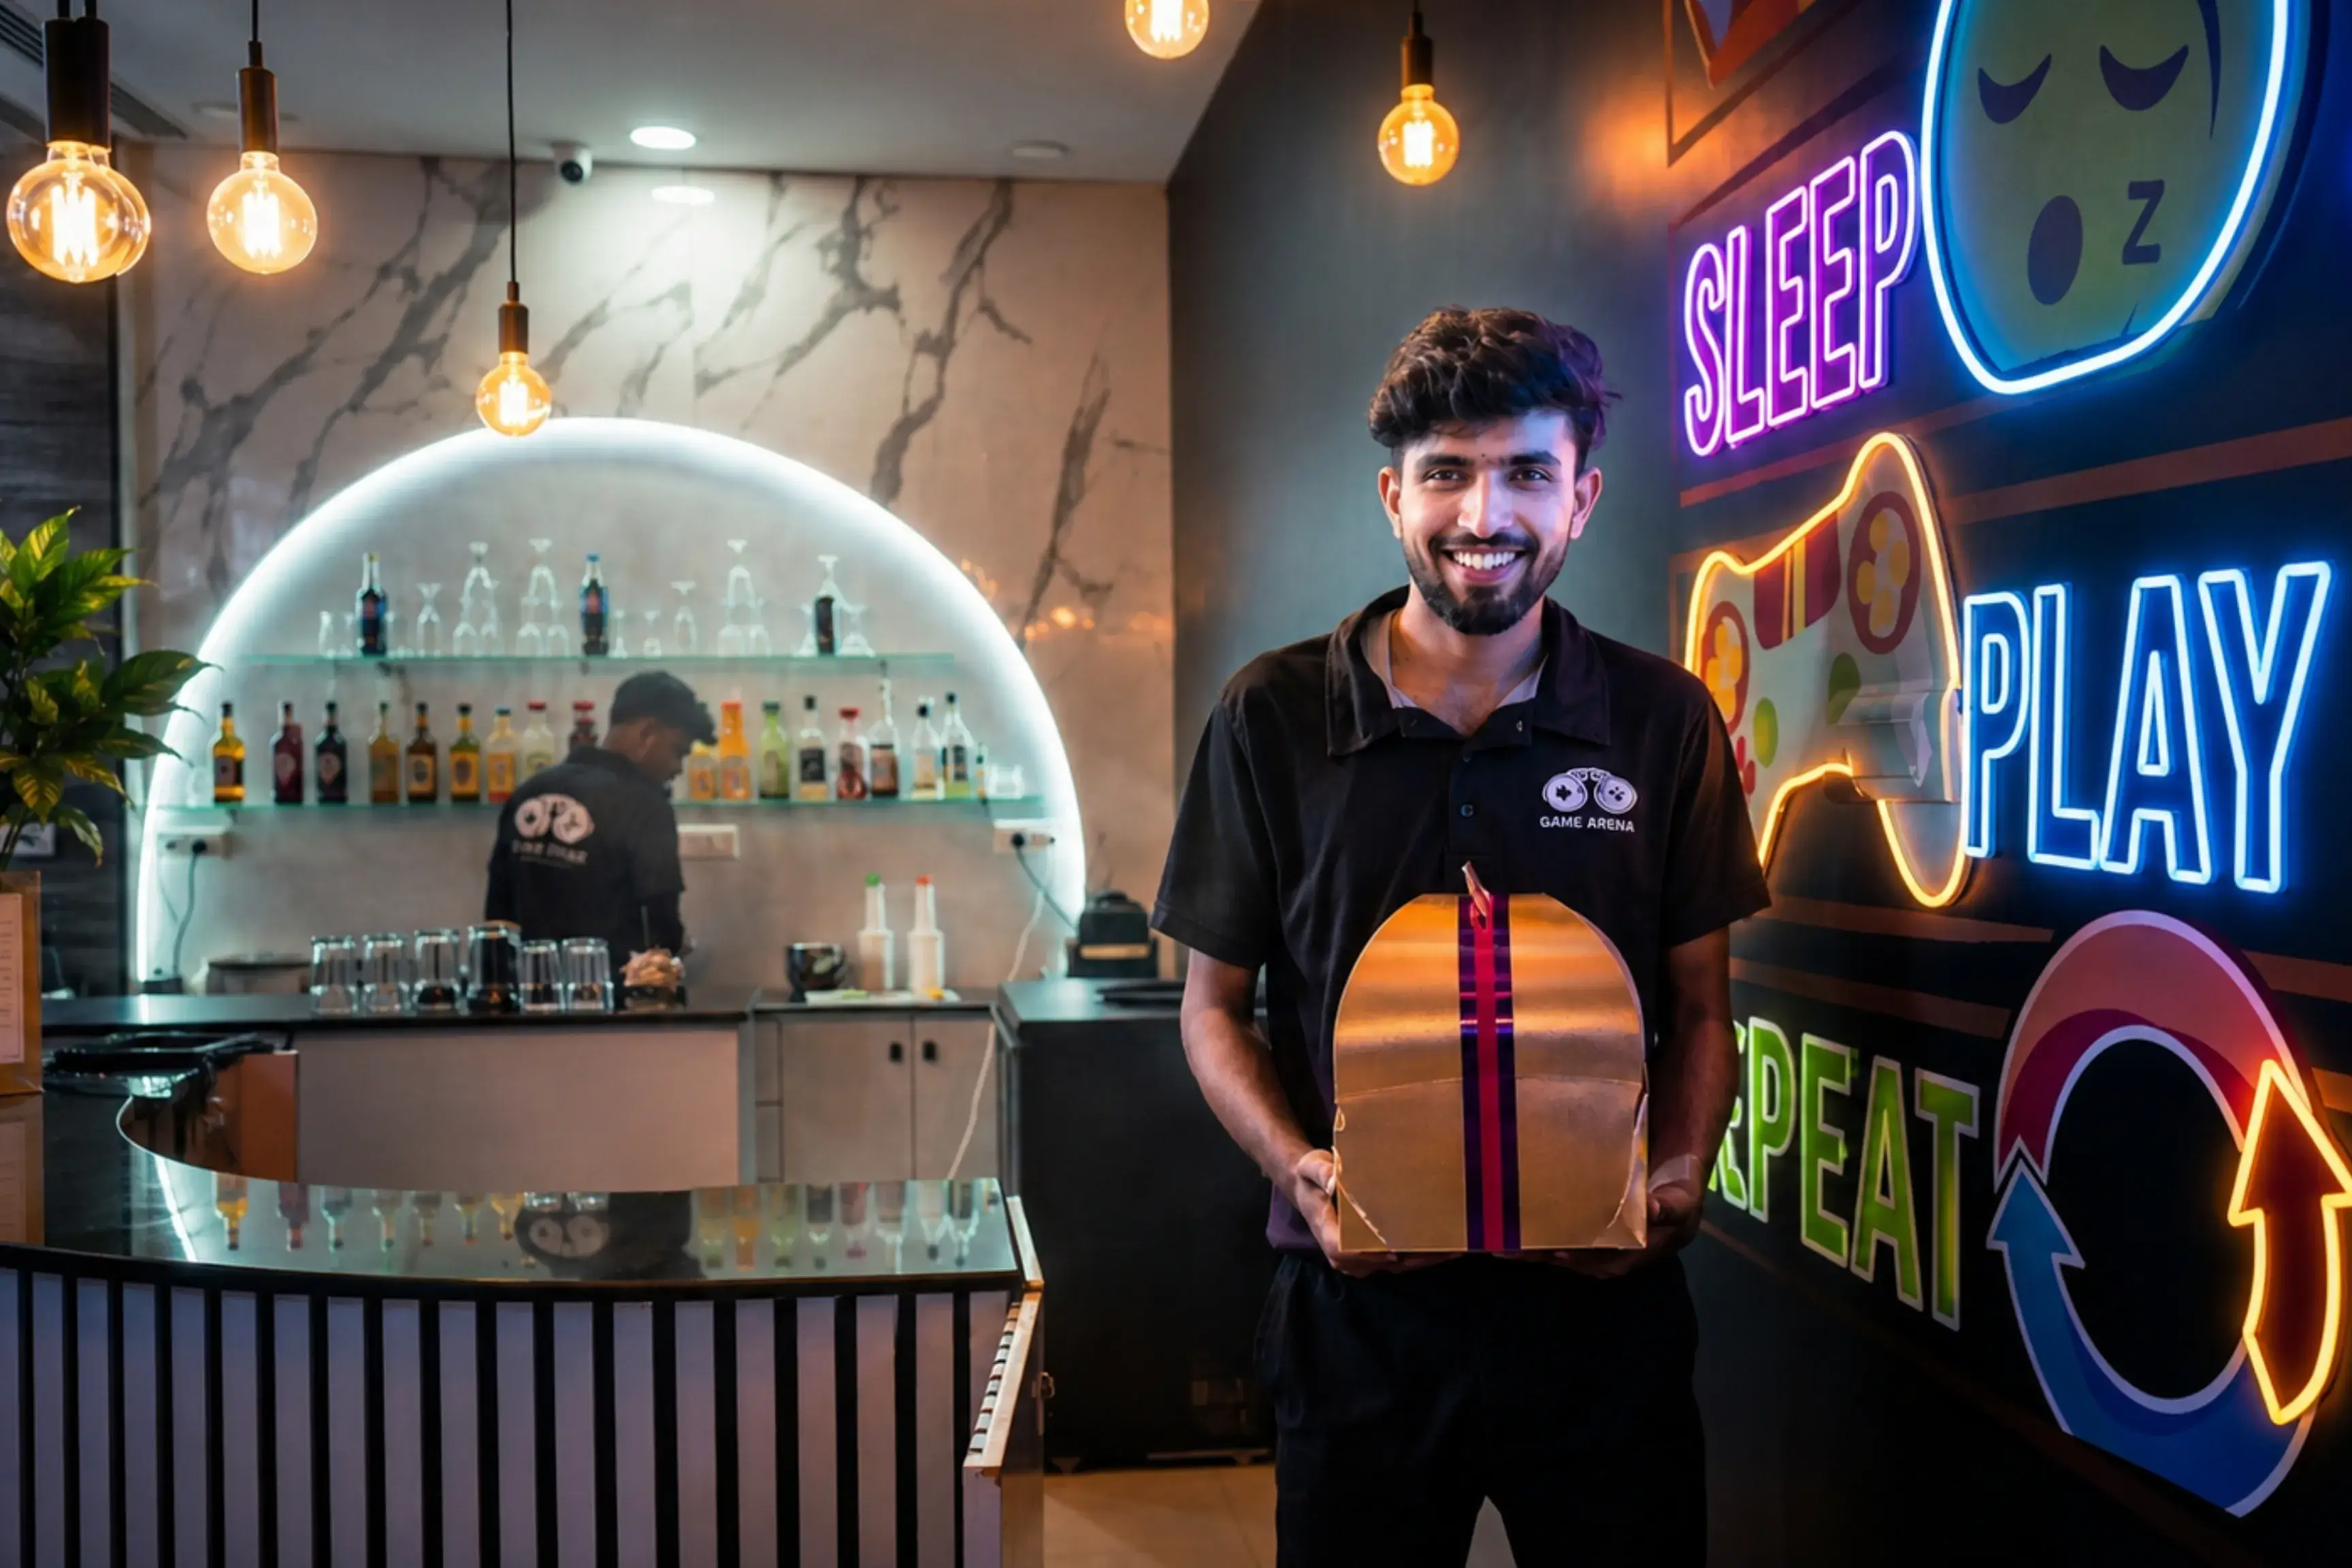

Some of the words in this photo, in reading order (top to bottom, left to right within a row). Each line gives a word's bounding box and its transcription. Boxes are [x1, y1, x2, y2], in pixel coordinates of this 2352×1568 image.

[1684, 129, 1918, 457] SLEEP
[2121, 179, 2166, 265] Z
[1539, 815, 1582, 828] GAME
[1586, 817, 1635, 832] ARENA
[1961, 560, 2333, 894] PLAY
[1708, 1015, 1980, 1331] PEAT
